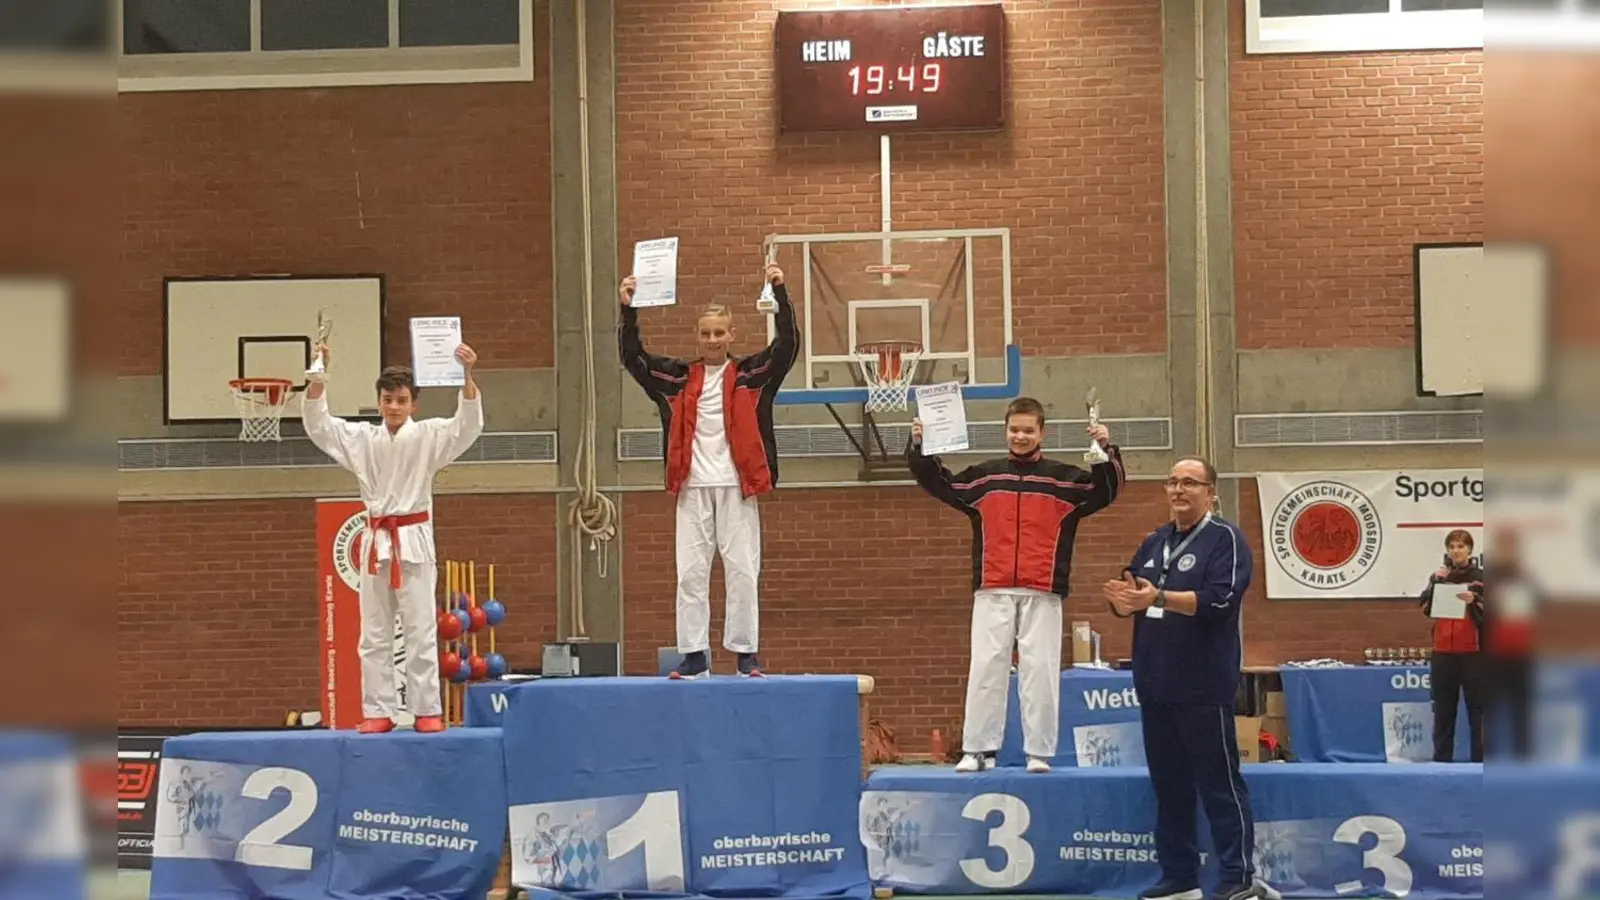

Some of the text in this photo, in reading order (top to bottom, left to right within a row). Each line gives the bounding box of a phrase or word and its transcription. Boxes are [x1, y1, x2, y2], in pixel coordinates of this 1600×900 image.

[802, 40, 850, 62] HEIM
[923, 32, 984, 58] GÄSTE
[848, 63, 940, 95] 19:49
[1395, 475, 1483, 502] Sportg
[1276, 486, 1377, 567] SPORTGEMEINSCHAFT MOOSBURG
[1301, 568, 1347, 584] KARATE
[235, 766, 318, 870] 2
[353, 809, 469, 833] oberbayrische
[338, 824, 478, 852] MEISTERSCHAFT
[606, 790, 686, 893] 1
[713, 831, 831, 850] oberbayrische
[958, 793, 1035, 888] 3
[701, 848, 845, 870] MEISTERSCHAFT
[1333, 815, 1413, 898] 3
[1438, 863, 1483, 877] MEIS
